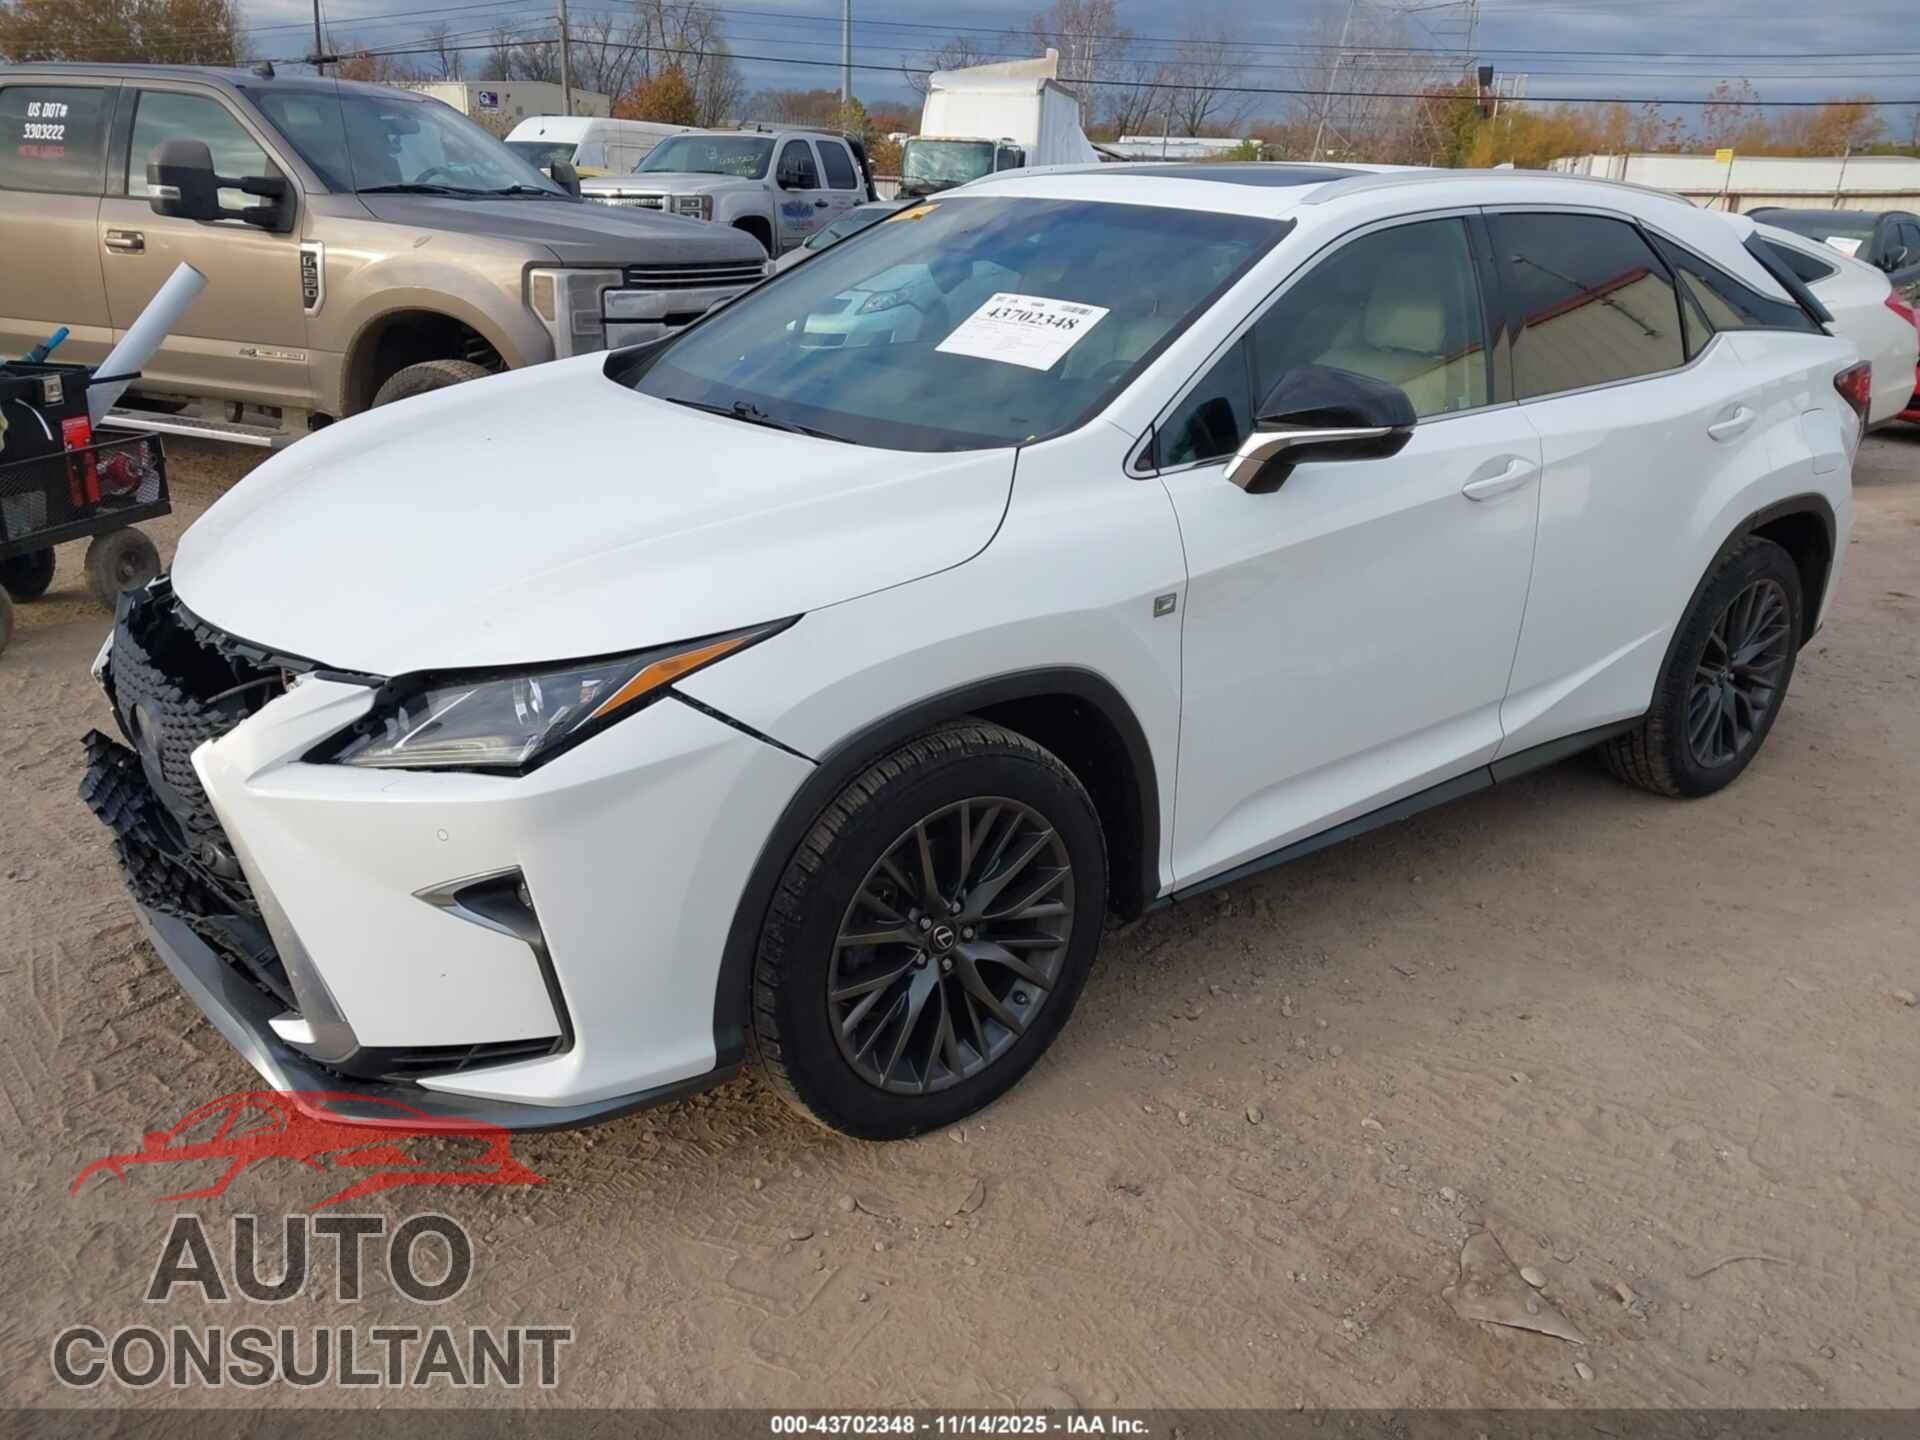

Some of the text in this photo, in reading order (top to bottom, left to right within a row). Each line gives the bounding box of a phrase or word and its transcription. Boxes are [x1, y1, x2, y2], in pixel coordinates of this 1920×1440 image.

[27, 101, 68, 118] US DOT#
[987, 307, 1080, 330] 43702348
